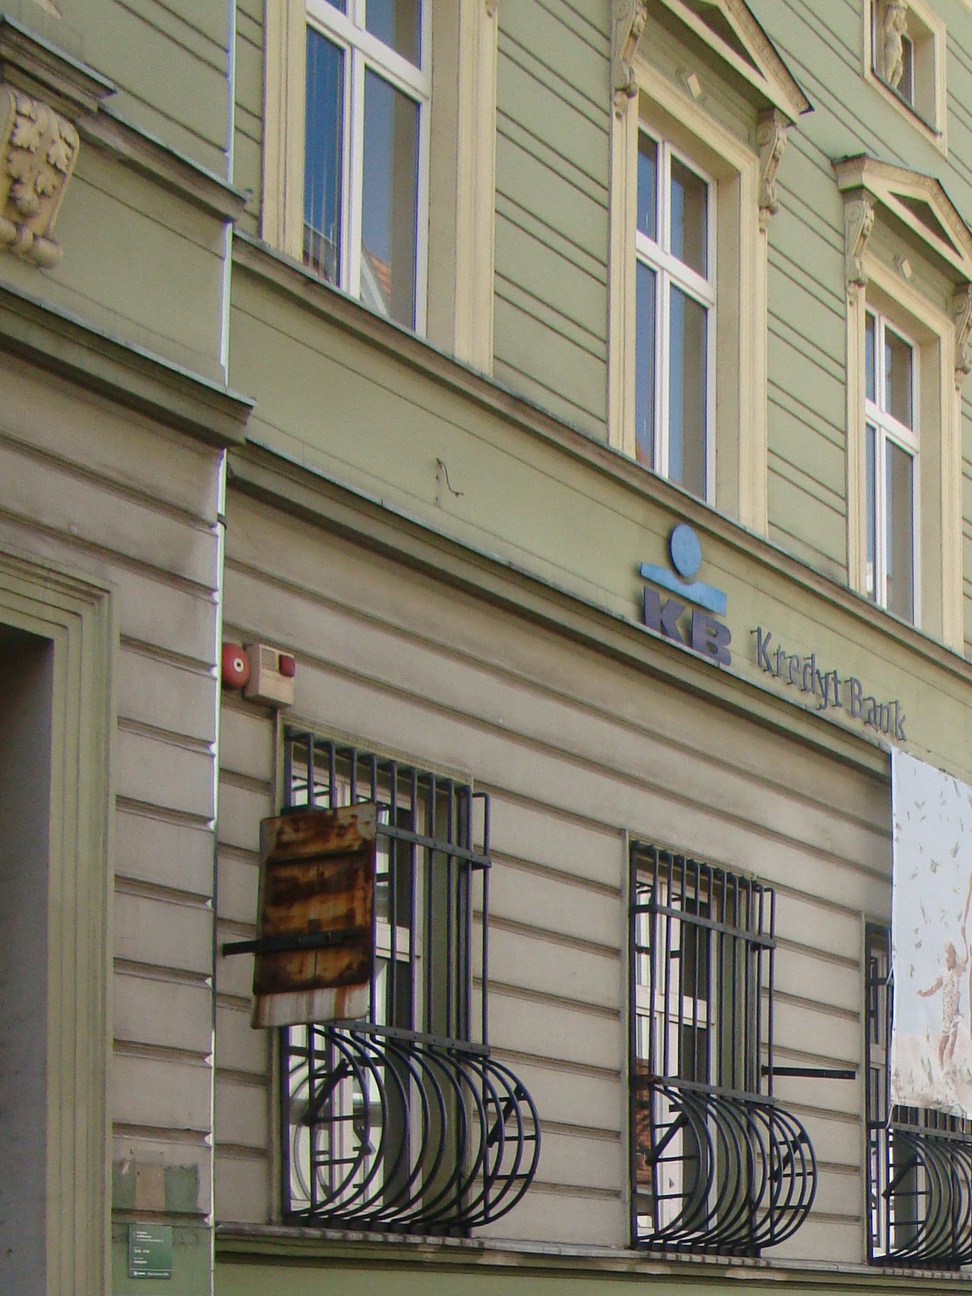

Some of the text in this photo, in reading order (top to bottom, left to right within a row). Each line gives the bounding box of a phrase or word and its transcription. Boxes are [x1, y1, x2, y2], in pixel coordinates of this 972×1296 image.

[644, 586, 732, 667] KB
[756, 626, 908, 742] Kredyt Bank
